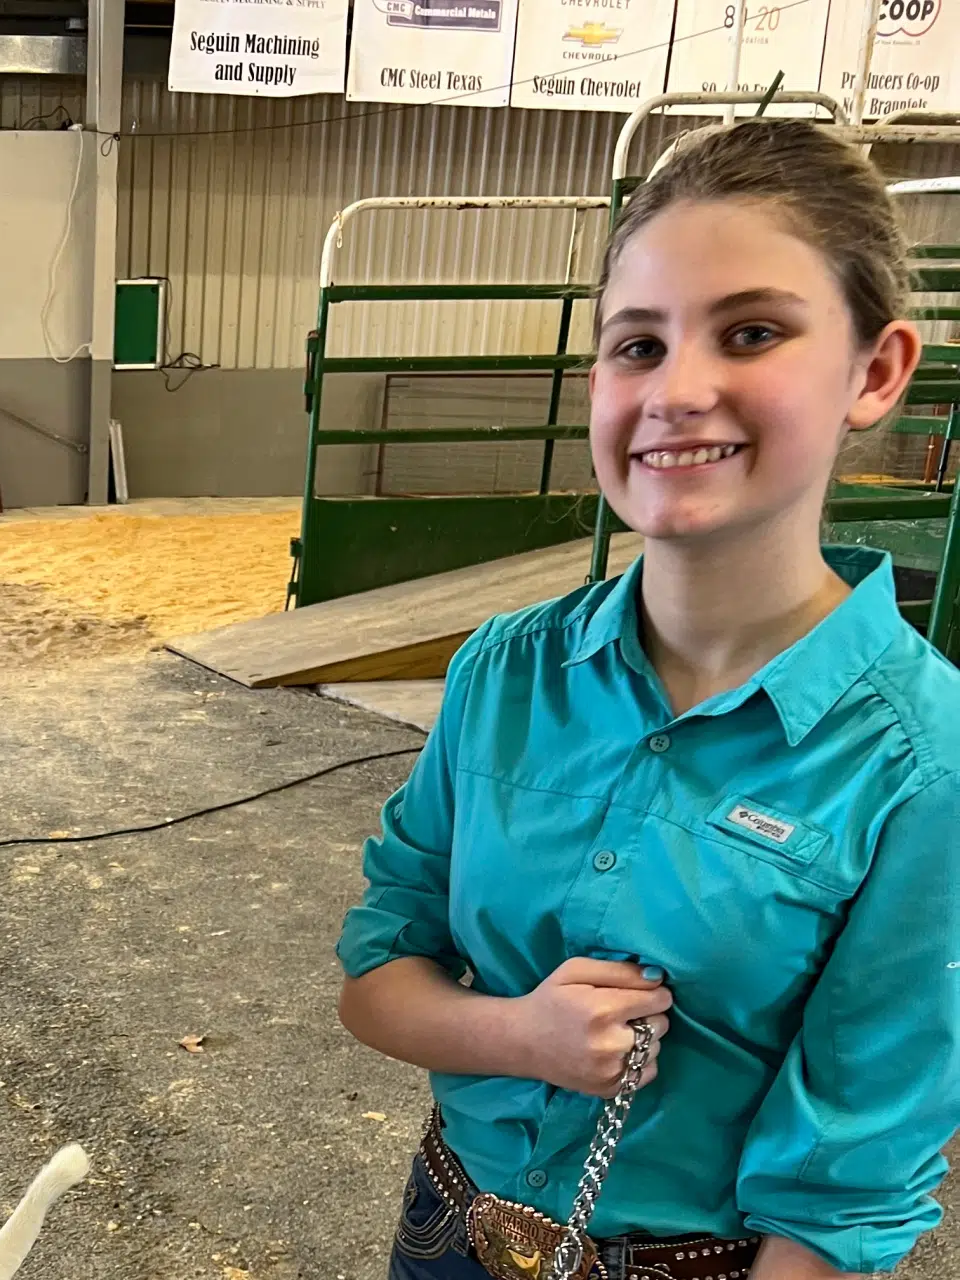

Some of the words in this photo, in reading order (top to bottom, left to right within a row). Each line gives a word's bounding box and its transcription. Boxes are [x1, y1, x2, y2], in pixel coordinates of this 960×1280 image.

[386, 1, 406, 13] CMC
[414, 4, 466, 18] Commercial
[467, 7, 496, 19] Metals
[190, 31, 240, 54] Seguin
[244, 34, 320, 59] Machining
[562, 51, 618, 61] CHEVROLET
[214, 62, 243, 81] and
[248, 63, 296, 86] Supply
[380, 67, 406, 88] CMC
[409, 69, 441, 90] Steel
[446, 71, 482, 91] Texas
[840, 71, 903, 90] Prucers
[906, 72, 940, 92] Co-op
[532, 75, 575, 96] Seguin
[580, 77, 641, 98] Chevrolet
[493, 1208, 538, 1241] NAVARRO
